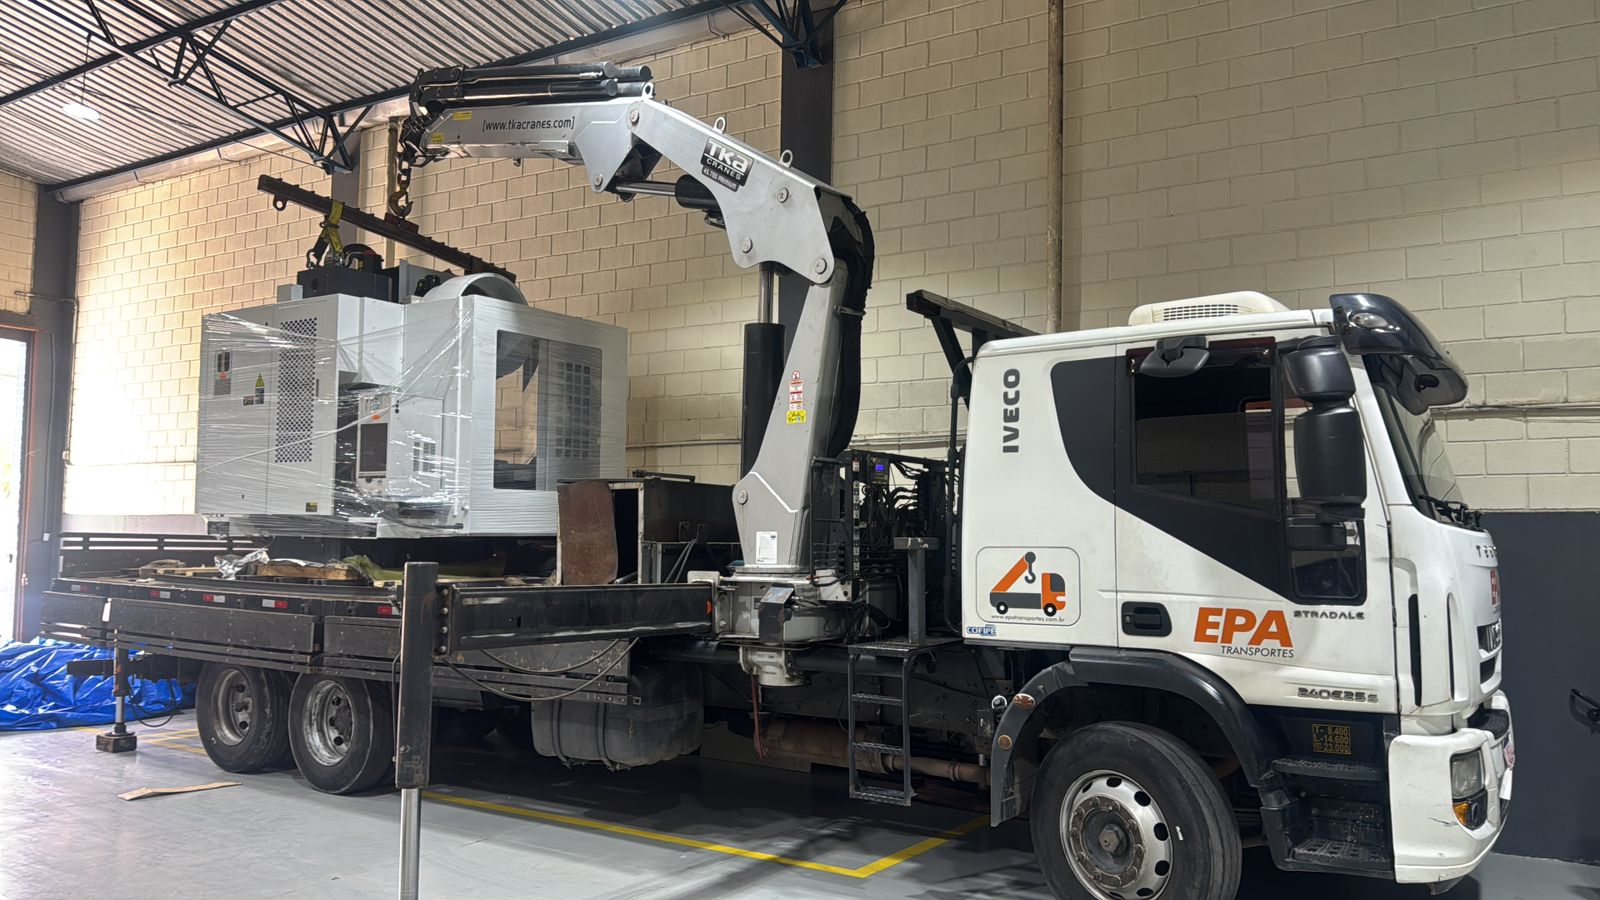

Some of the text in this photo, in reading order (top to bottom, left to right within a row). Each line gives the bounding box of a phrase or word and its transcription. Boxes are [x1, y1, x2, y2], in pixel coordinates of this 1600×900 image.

[706, 158, 742, 180] CRANES
[1002, 368, 1020, 453] IVECO
[991, 615, 1065, 623] www.epatransportes.com.br
[1293, 610, 1365, 620] STRADALE
[1193, 606, 1293, 648] EPA
[1220, 645, 1294, 659] TRANSPORTES
